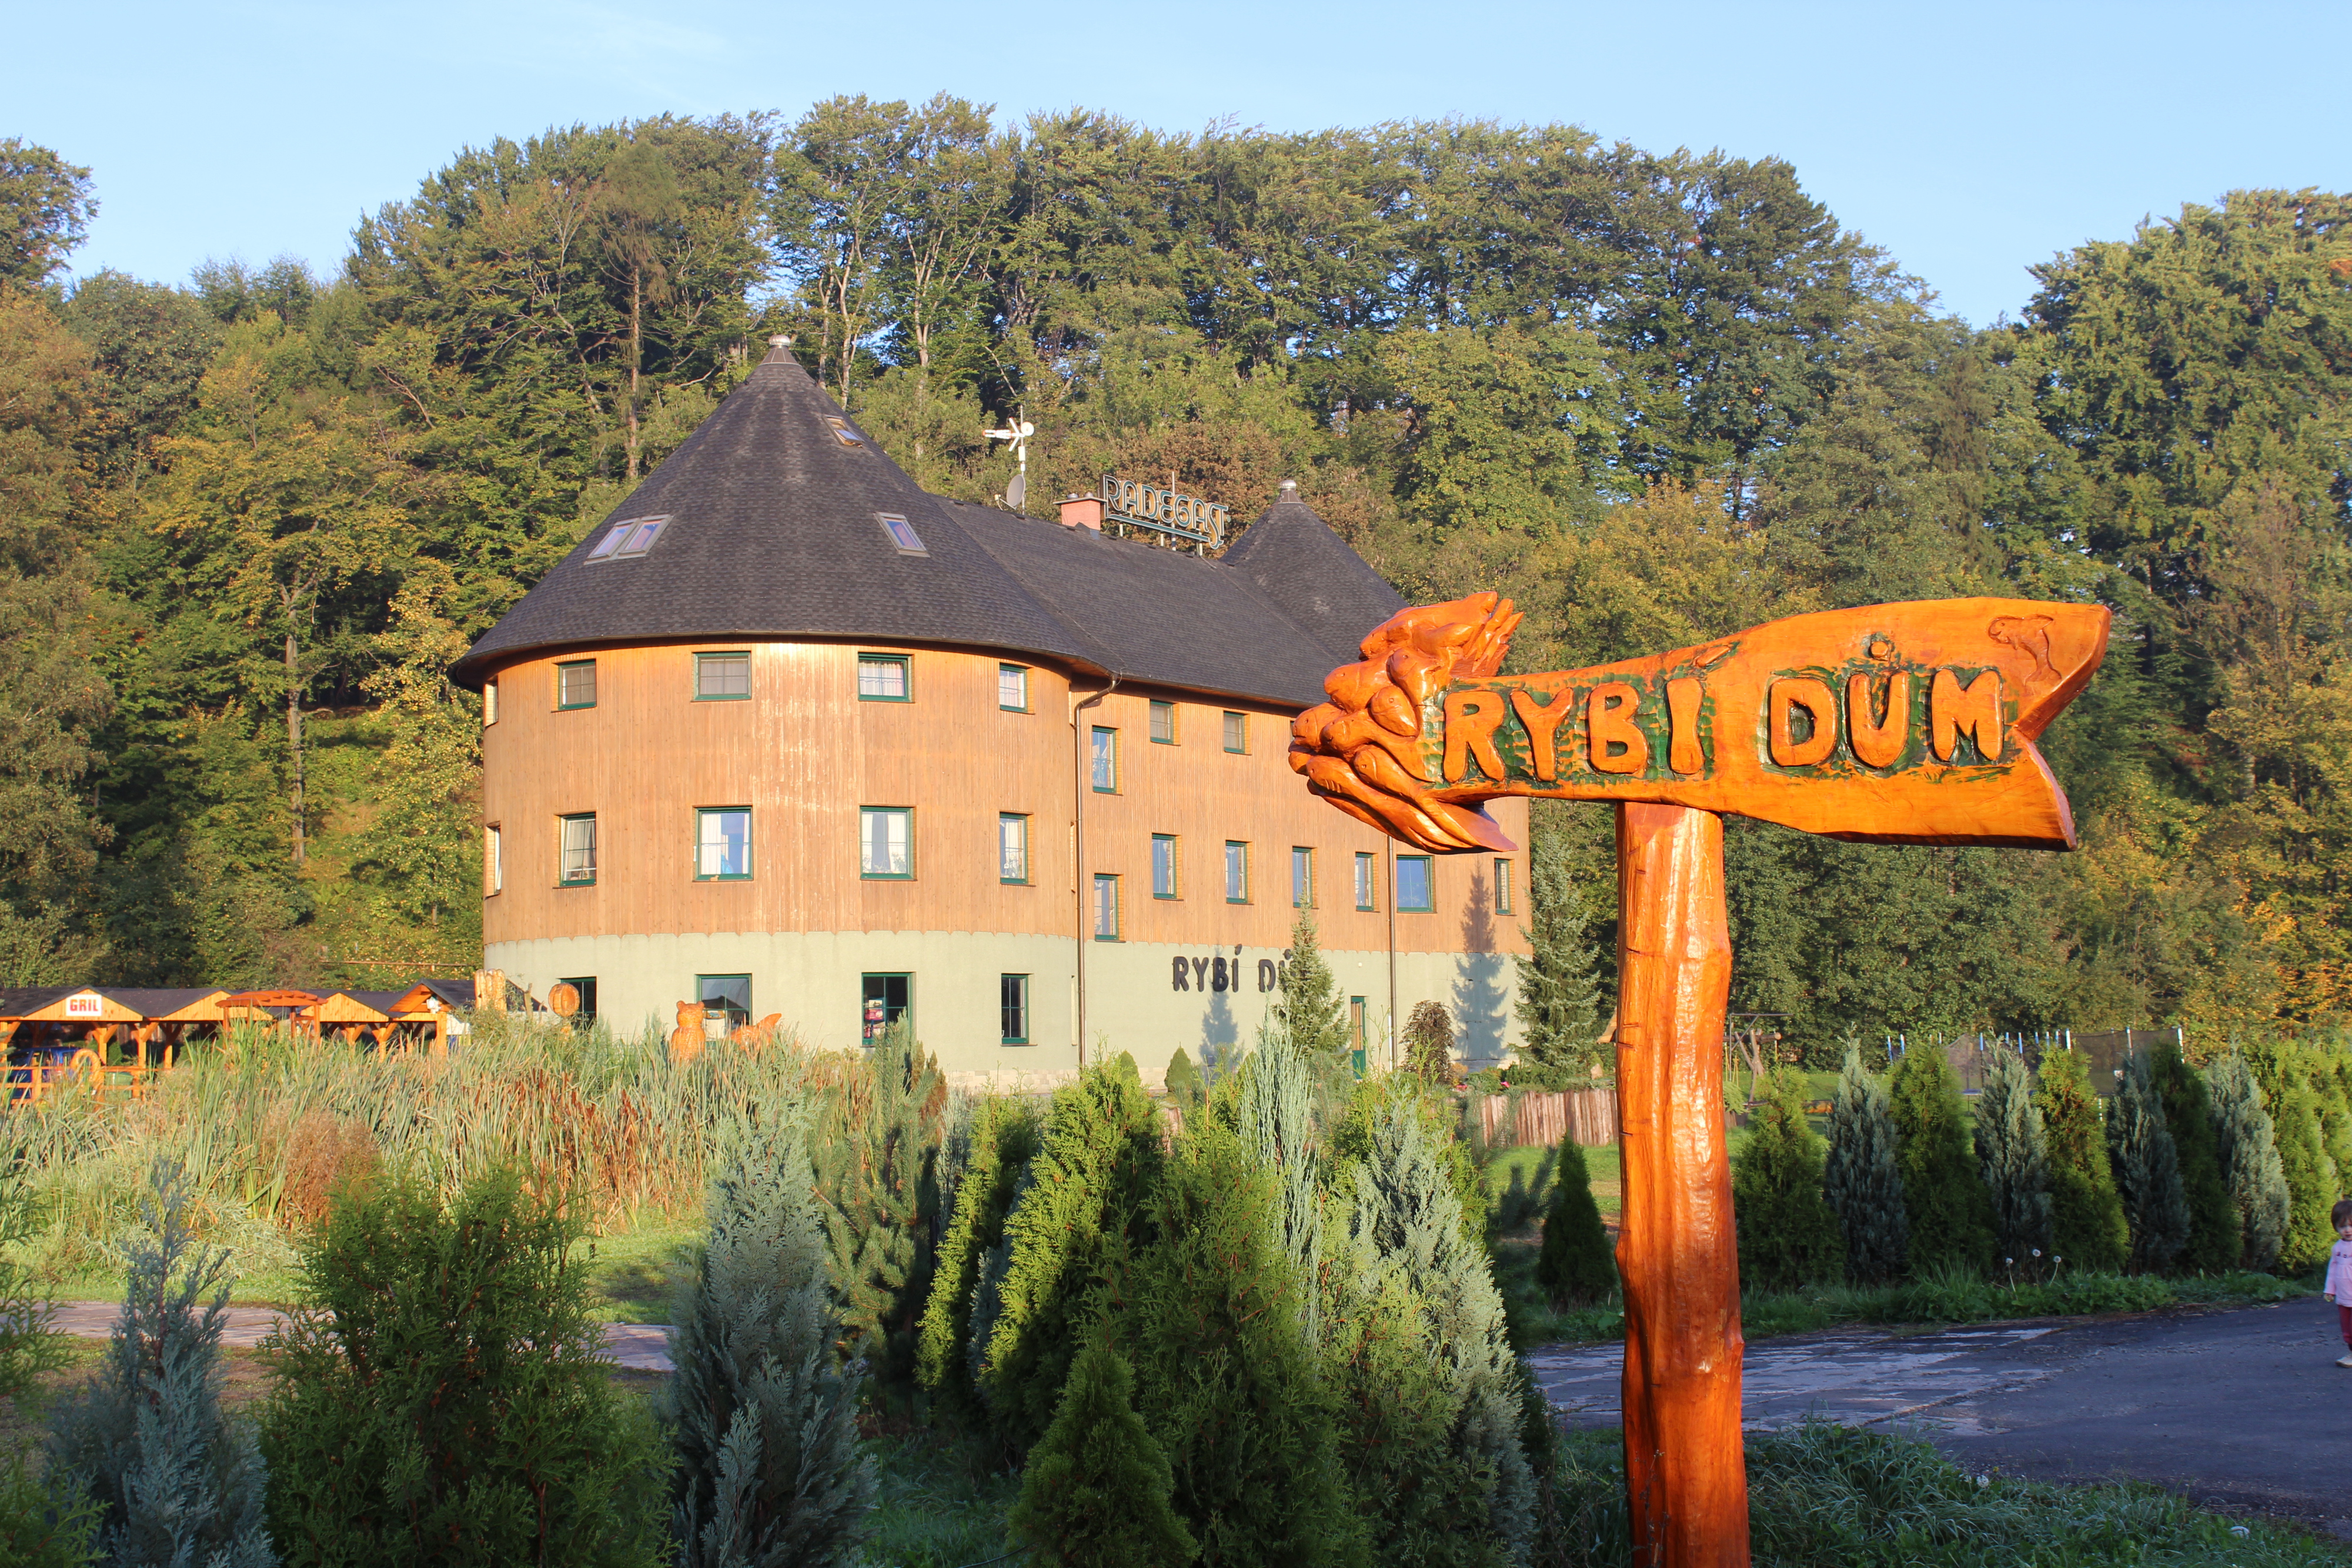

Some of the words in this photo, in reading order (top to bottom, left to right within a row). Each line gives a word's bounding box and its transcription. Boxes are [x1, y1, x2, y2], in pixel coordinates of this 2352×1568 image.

[1101, 474, 1229, 549] RADEGAST
[1443, 646, 1731, 783] RYBÍ
[1172, 944, 1242, 992] RYBÍ
[70, 999, 98, 1011] GRIL
